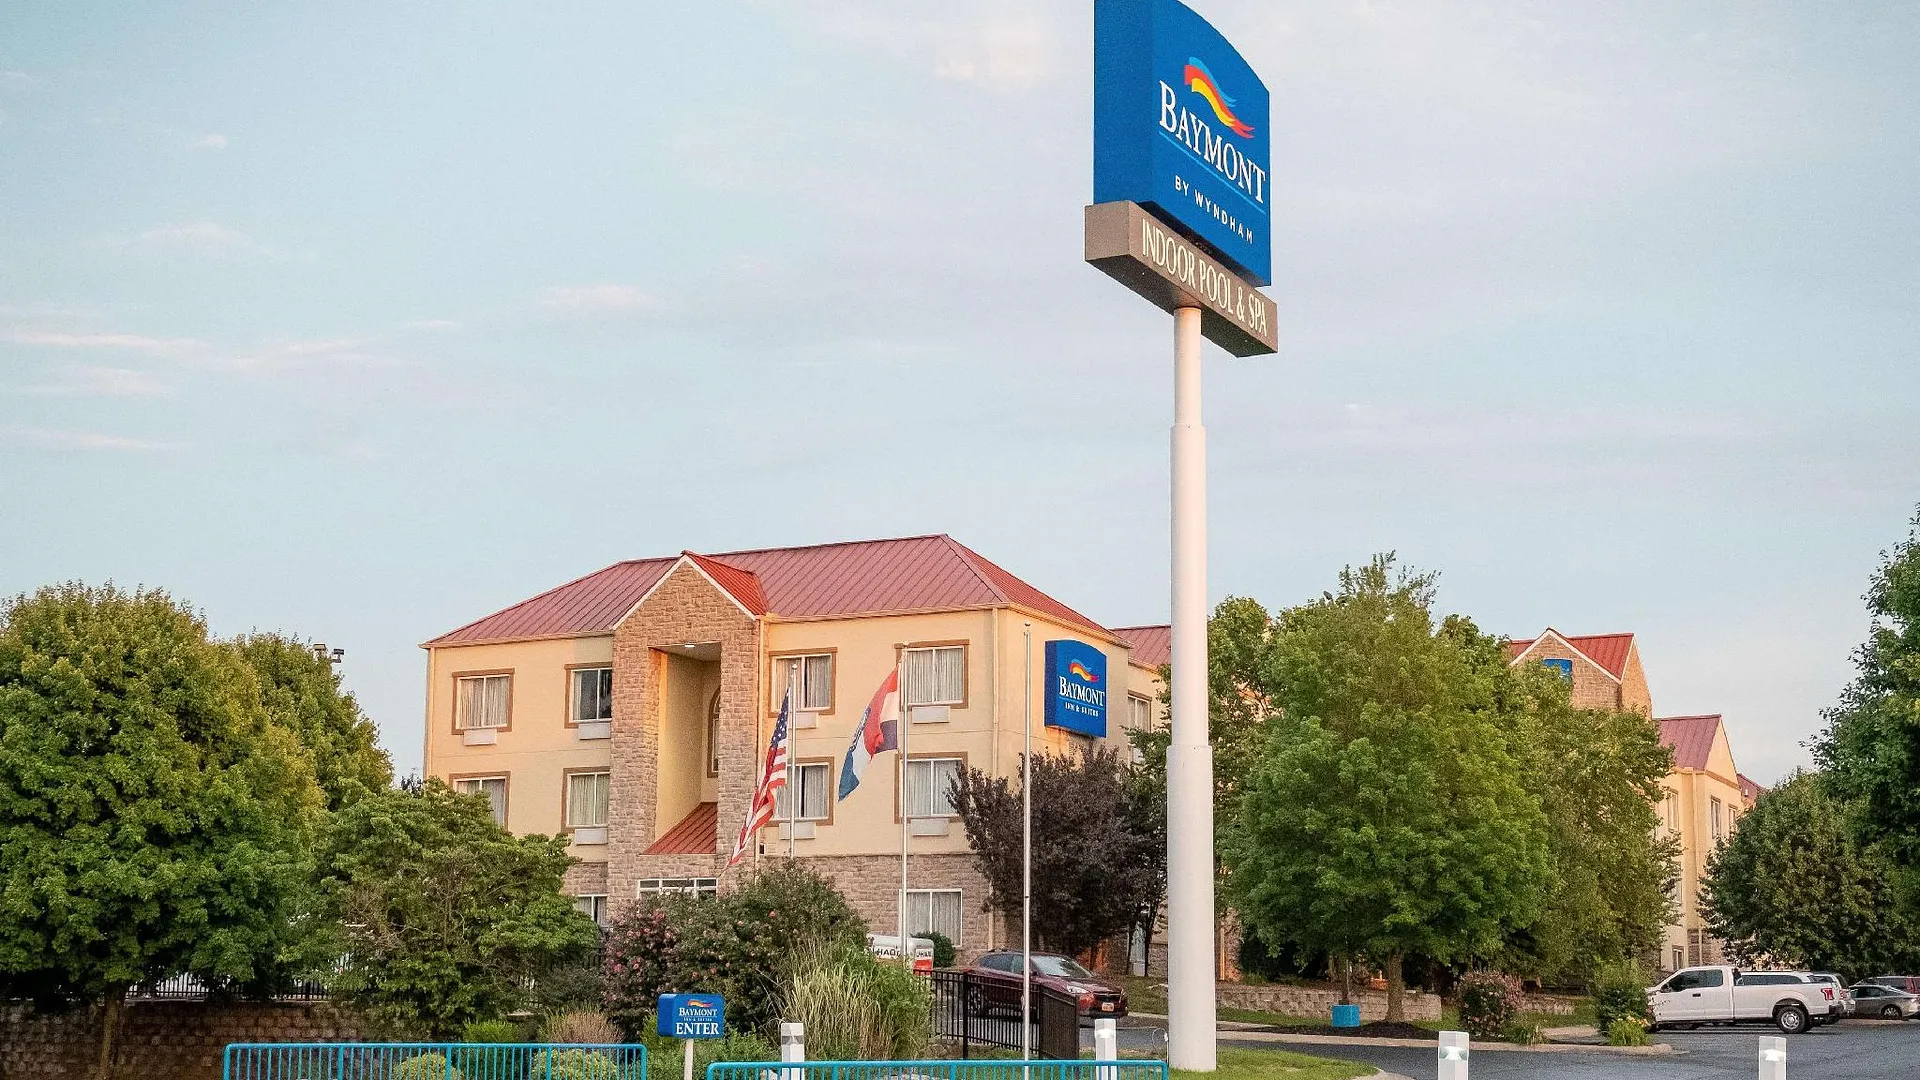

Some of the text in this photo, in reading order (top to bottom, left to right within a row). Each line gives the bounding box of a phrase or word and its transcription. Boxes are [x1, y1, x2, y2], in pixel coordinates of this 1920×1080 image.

[1159, 80, 1265, 204] BAYMONT
[1175, 175, 1253, 244] BY WYNDHAM
[1142, 218, 1267, 337] INDOOR POOL & SPA
[1059, 676, 1105, 706] BAYMONT
[676, 1022, 719, 1035] ENTER
[679, 1007, 717, 1016] BAYMONT
